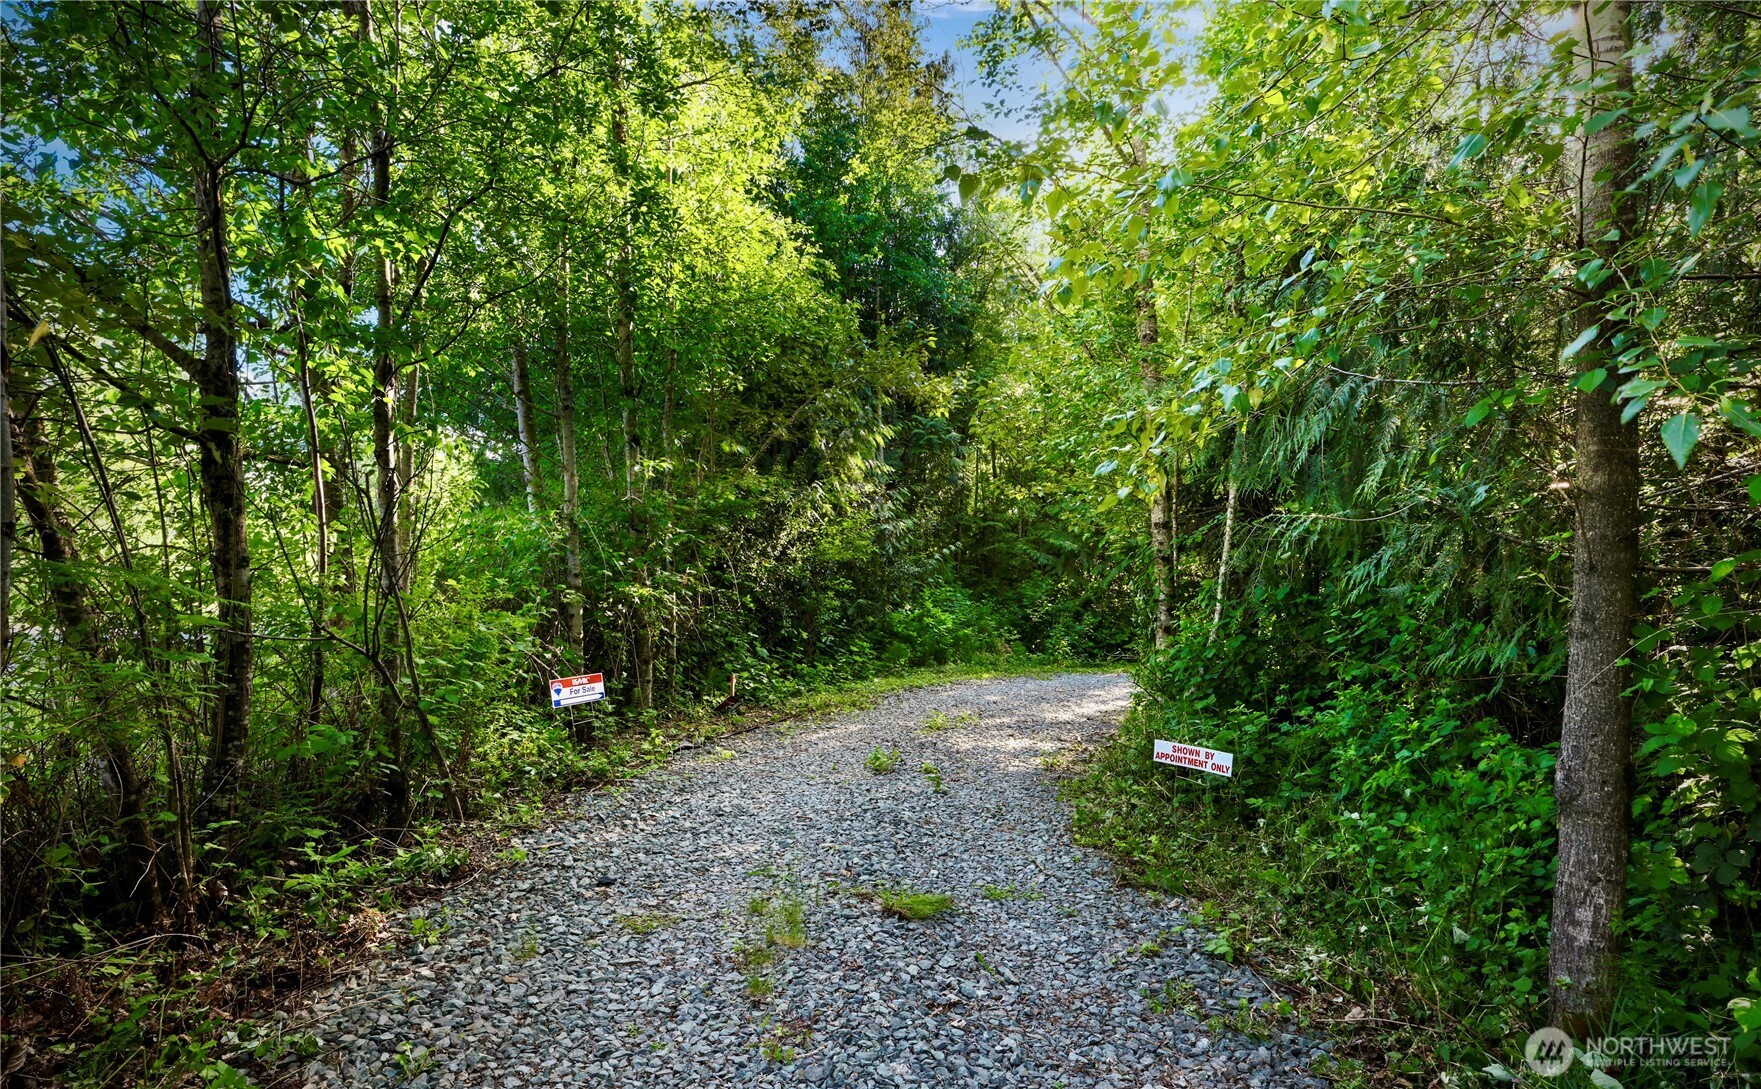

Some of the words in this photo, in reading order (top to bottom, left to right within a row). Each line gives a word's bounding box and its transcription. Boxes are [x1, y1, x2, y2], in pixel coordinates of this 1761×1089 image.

[1172, 745, 1200, 758] SHOWN
[1205, 752, 1214, 760] BY
[1155, 752, 1208, 768] APPOINTMENT
[1211, 762, 1230, 774] ONLY
